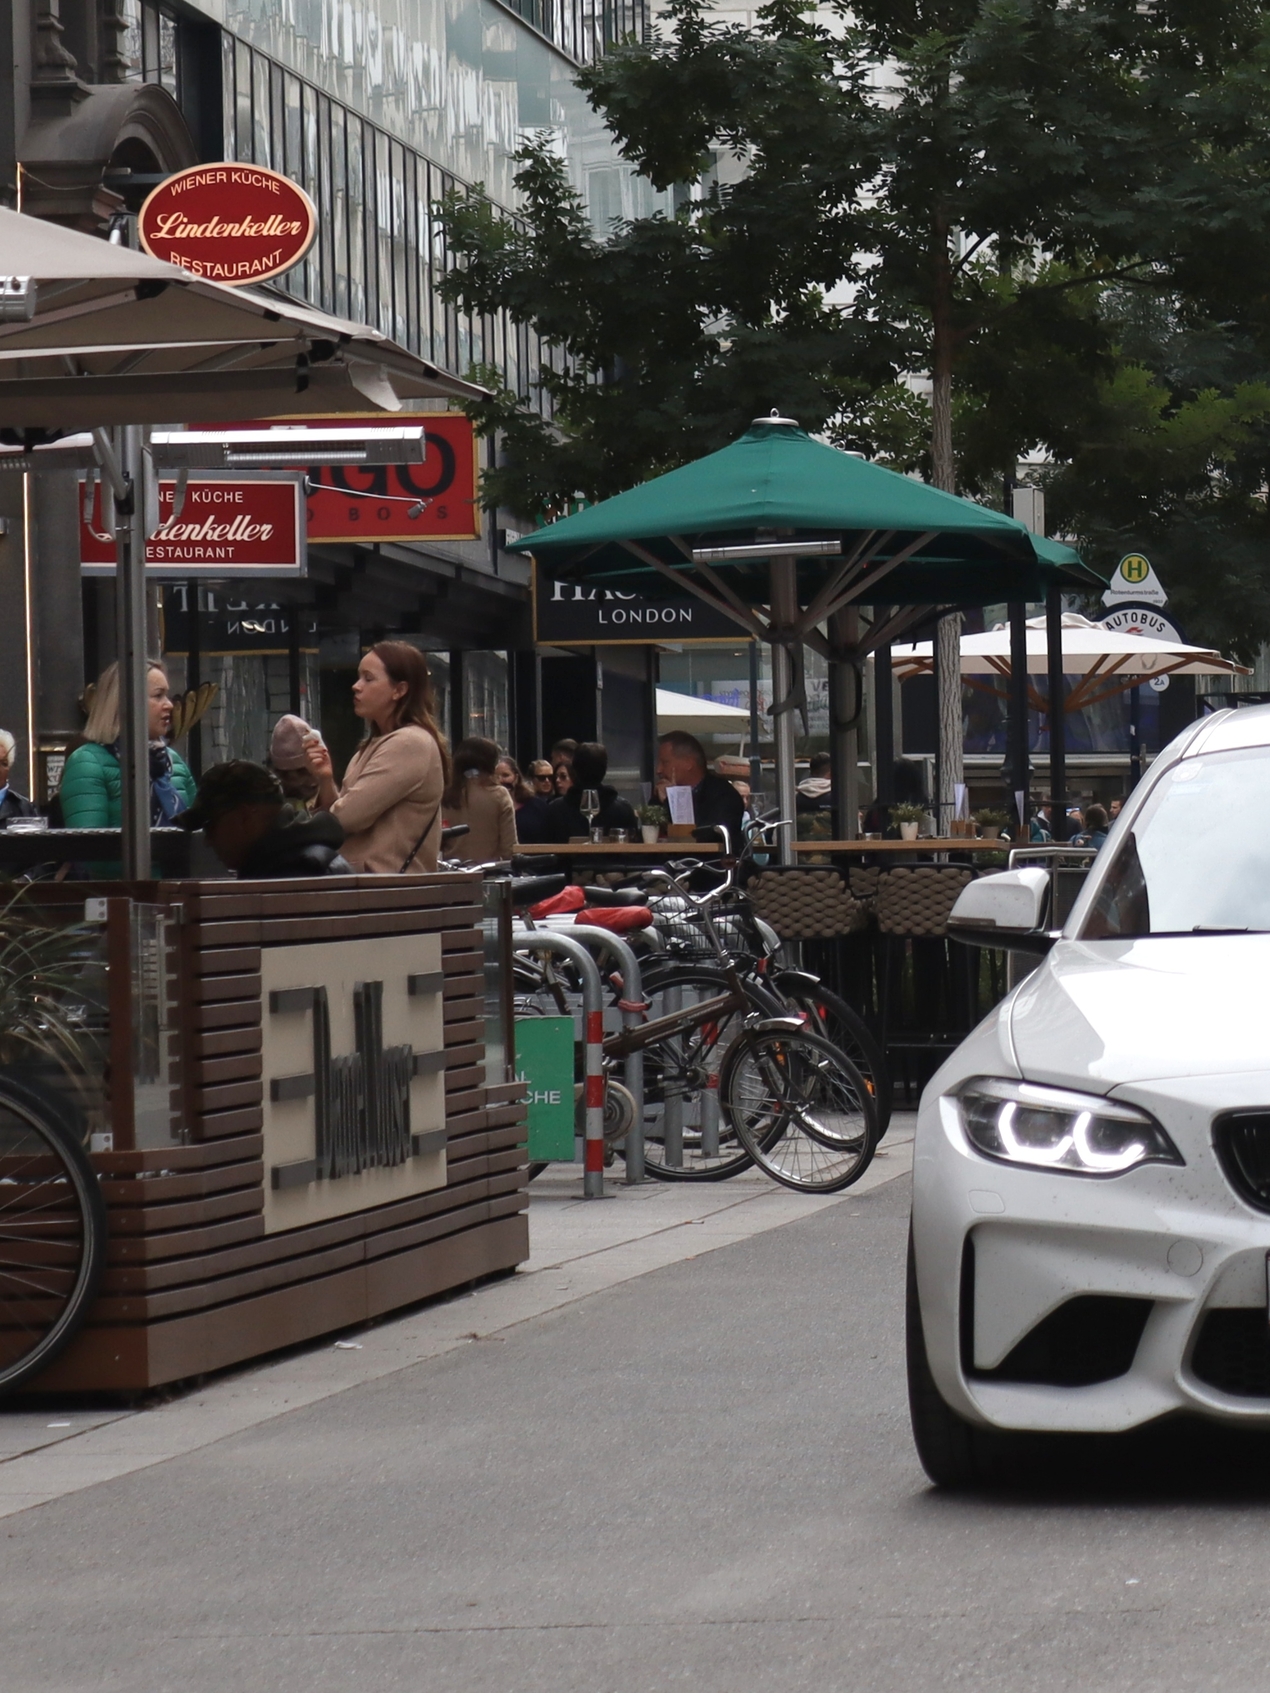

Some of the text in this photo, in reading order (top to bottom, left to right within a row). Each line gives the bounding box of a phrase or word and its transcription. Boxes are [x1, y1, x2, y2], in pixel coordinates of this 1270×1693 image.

[170, 170, 281, 197] WIENER KÜCHE
[150, 212, 303, 239] Lindenkeller
[170, 249, 283, 277] RESTAURANT
[192, 489, 244, 503] KÜCHE
[349, 506, 448, 522] BOS
[146, 547, 235, 559] ESTAURANT
[1127, 560, 1142, 579] H
[598, 608, 693, 625] LONDON
[1105, 611, 1166, 633] AUTOBUS
